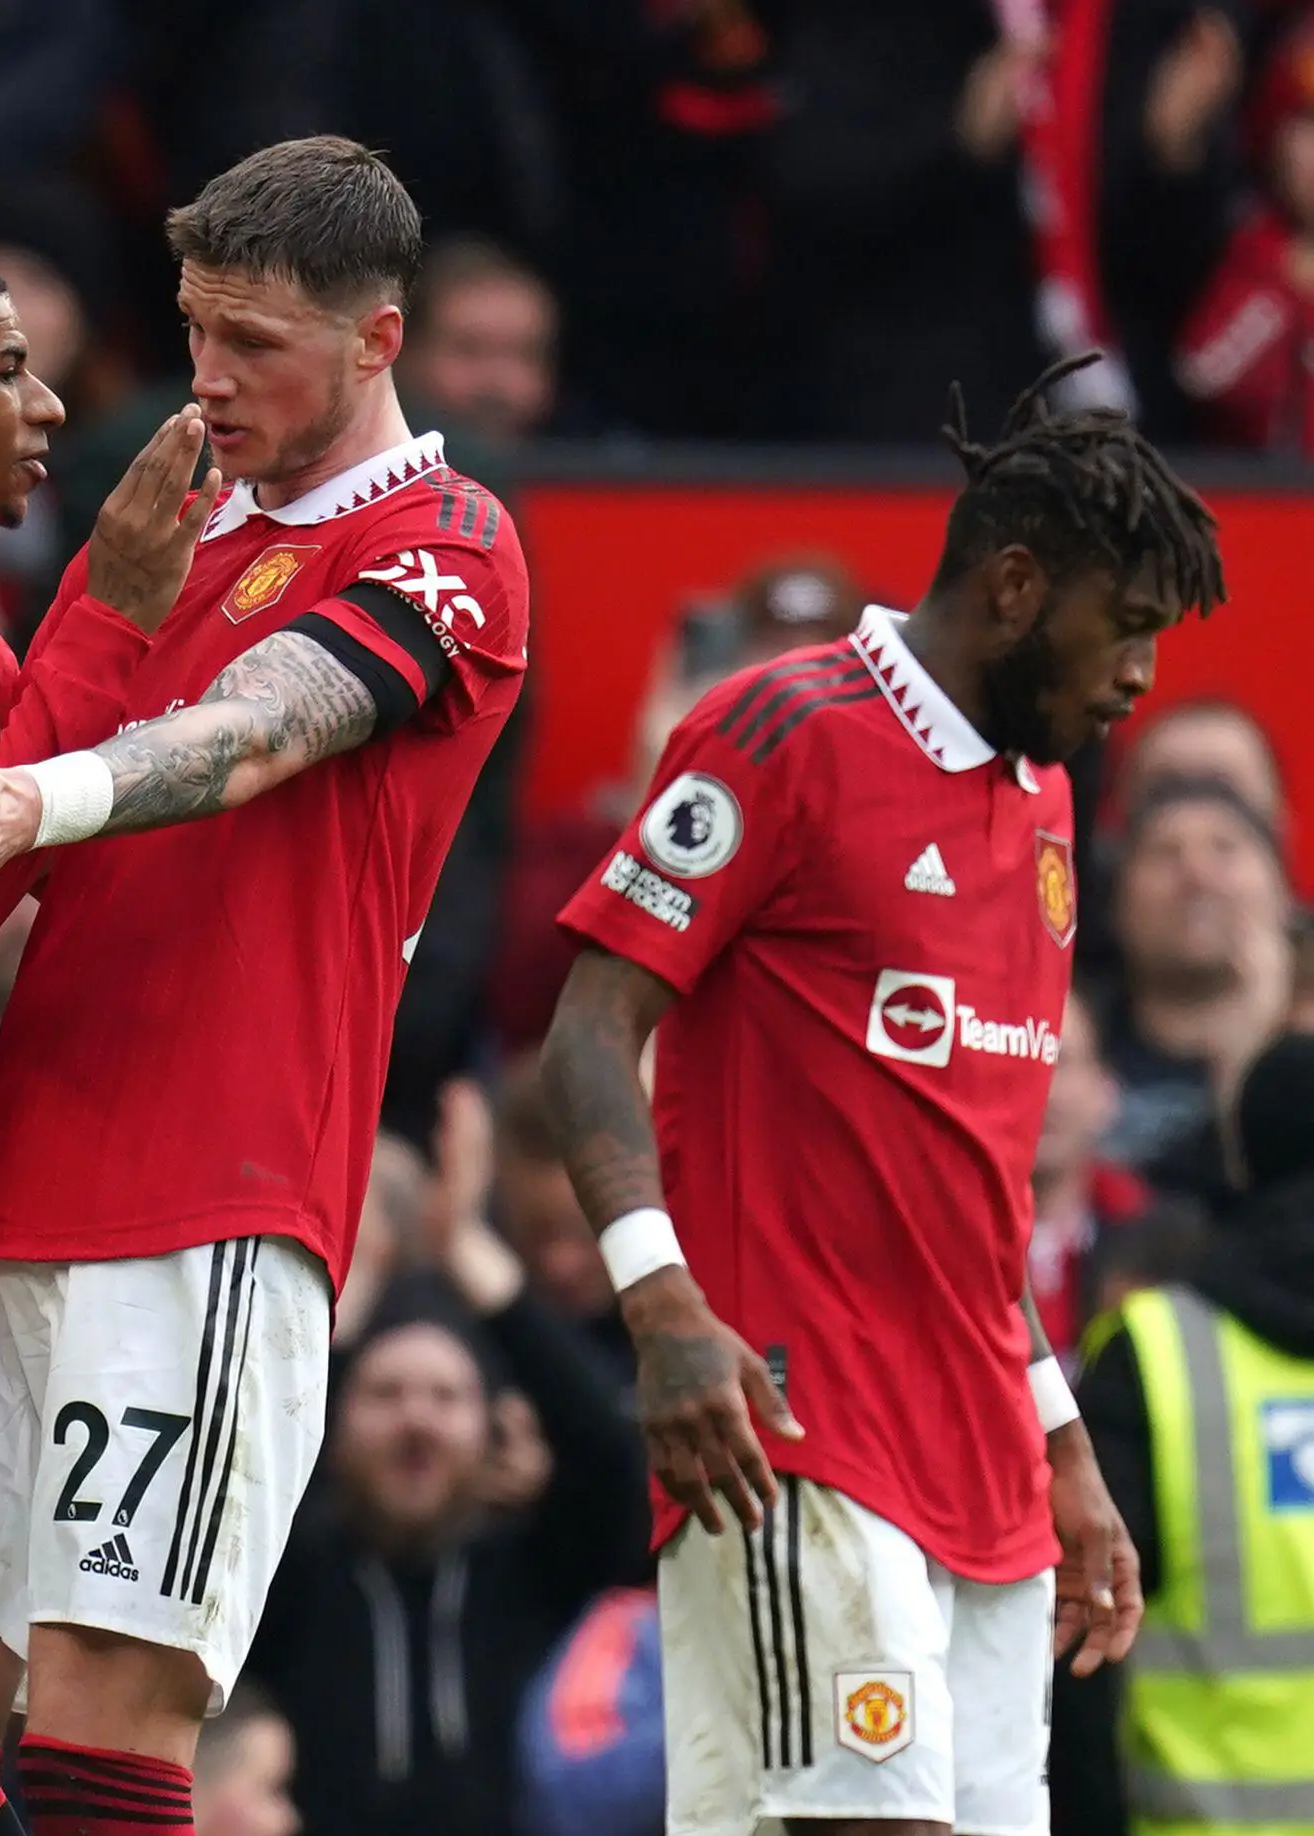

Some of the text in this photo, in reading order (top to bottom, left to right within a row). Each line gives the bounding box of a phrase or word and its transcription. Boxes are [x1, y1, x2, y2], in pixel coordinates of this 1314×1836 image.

[637, 868, 692, 912] room
[955, 1004, 1061, 1066] TeamVie
[52, 1400, 192, 1528] 27
[79, 1558, 139, 1582] adidas
